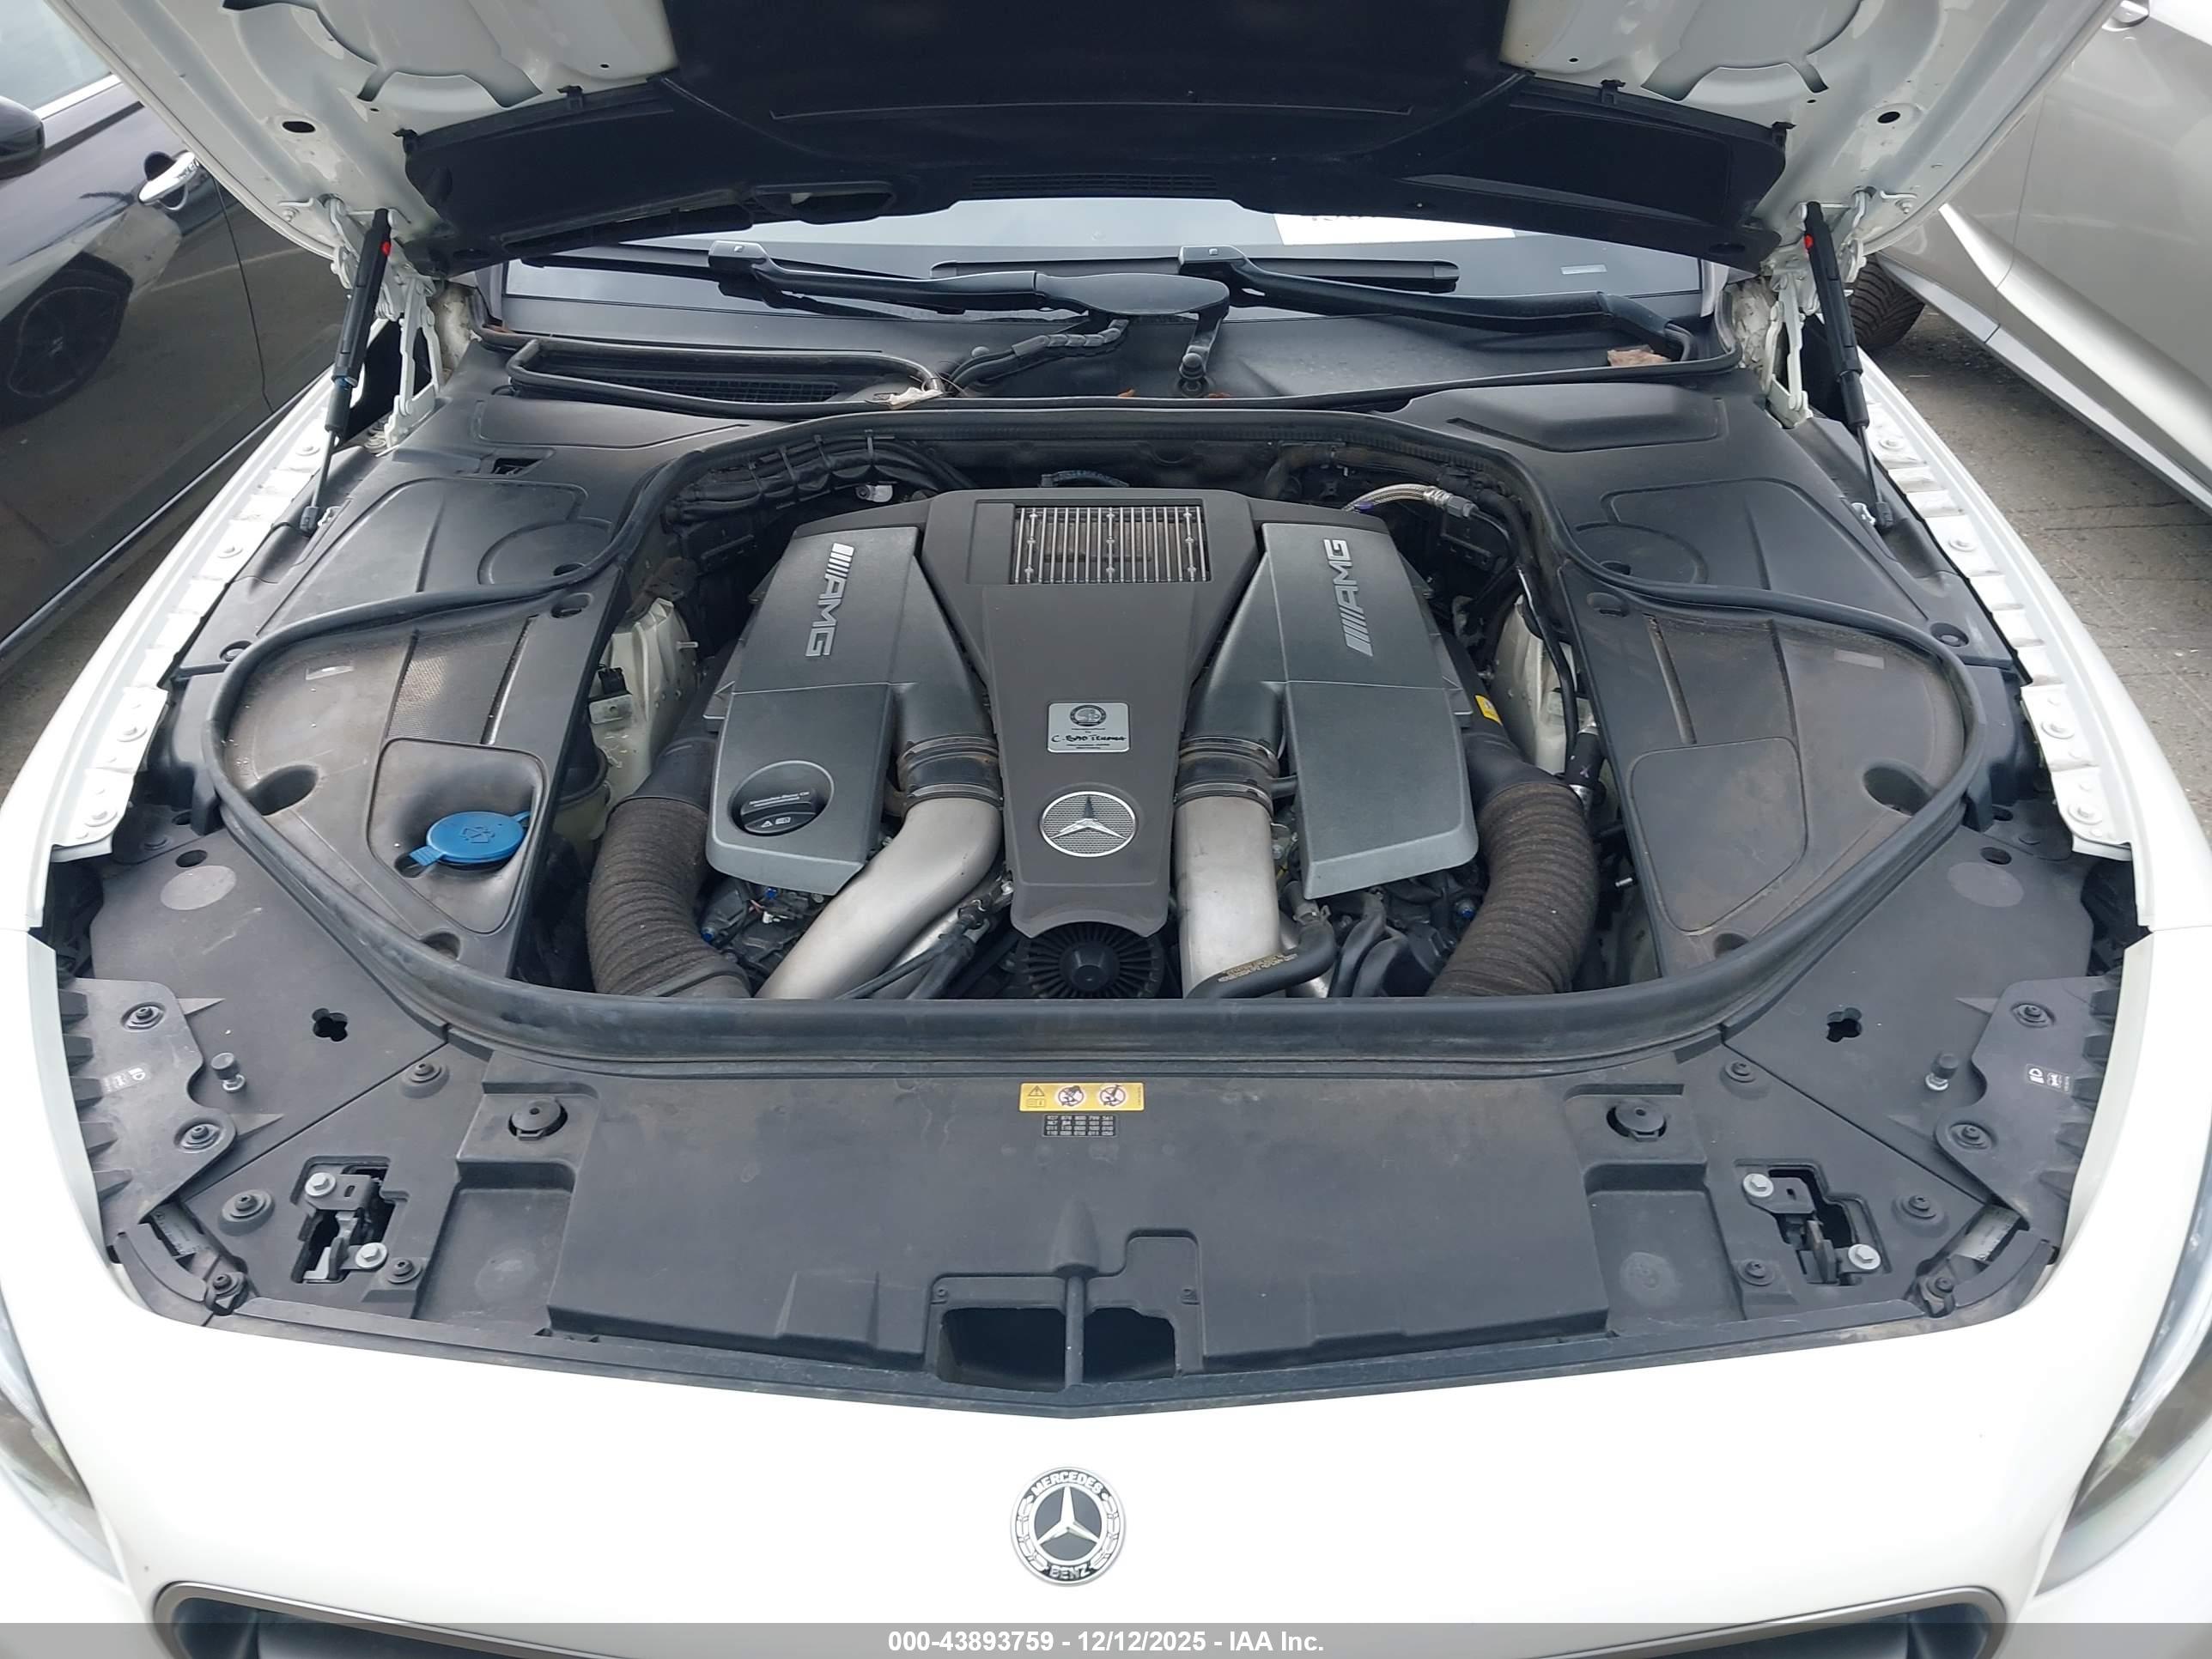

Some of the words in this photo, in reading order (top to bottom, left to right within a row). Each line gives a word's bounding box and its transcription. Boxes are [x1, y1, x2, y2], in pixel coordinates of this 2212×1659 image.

[1323, 538, 1364, 615] AMG
[805, 573, 848, 658] AMG
[1030, 1470, 1105, 1497] MERCEDES
[1048, 1564, 1092, 1580] BENZ
